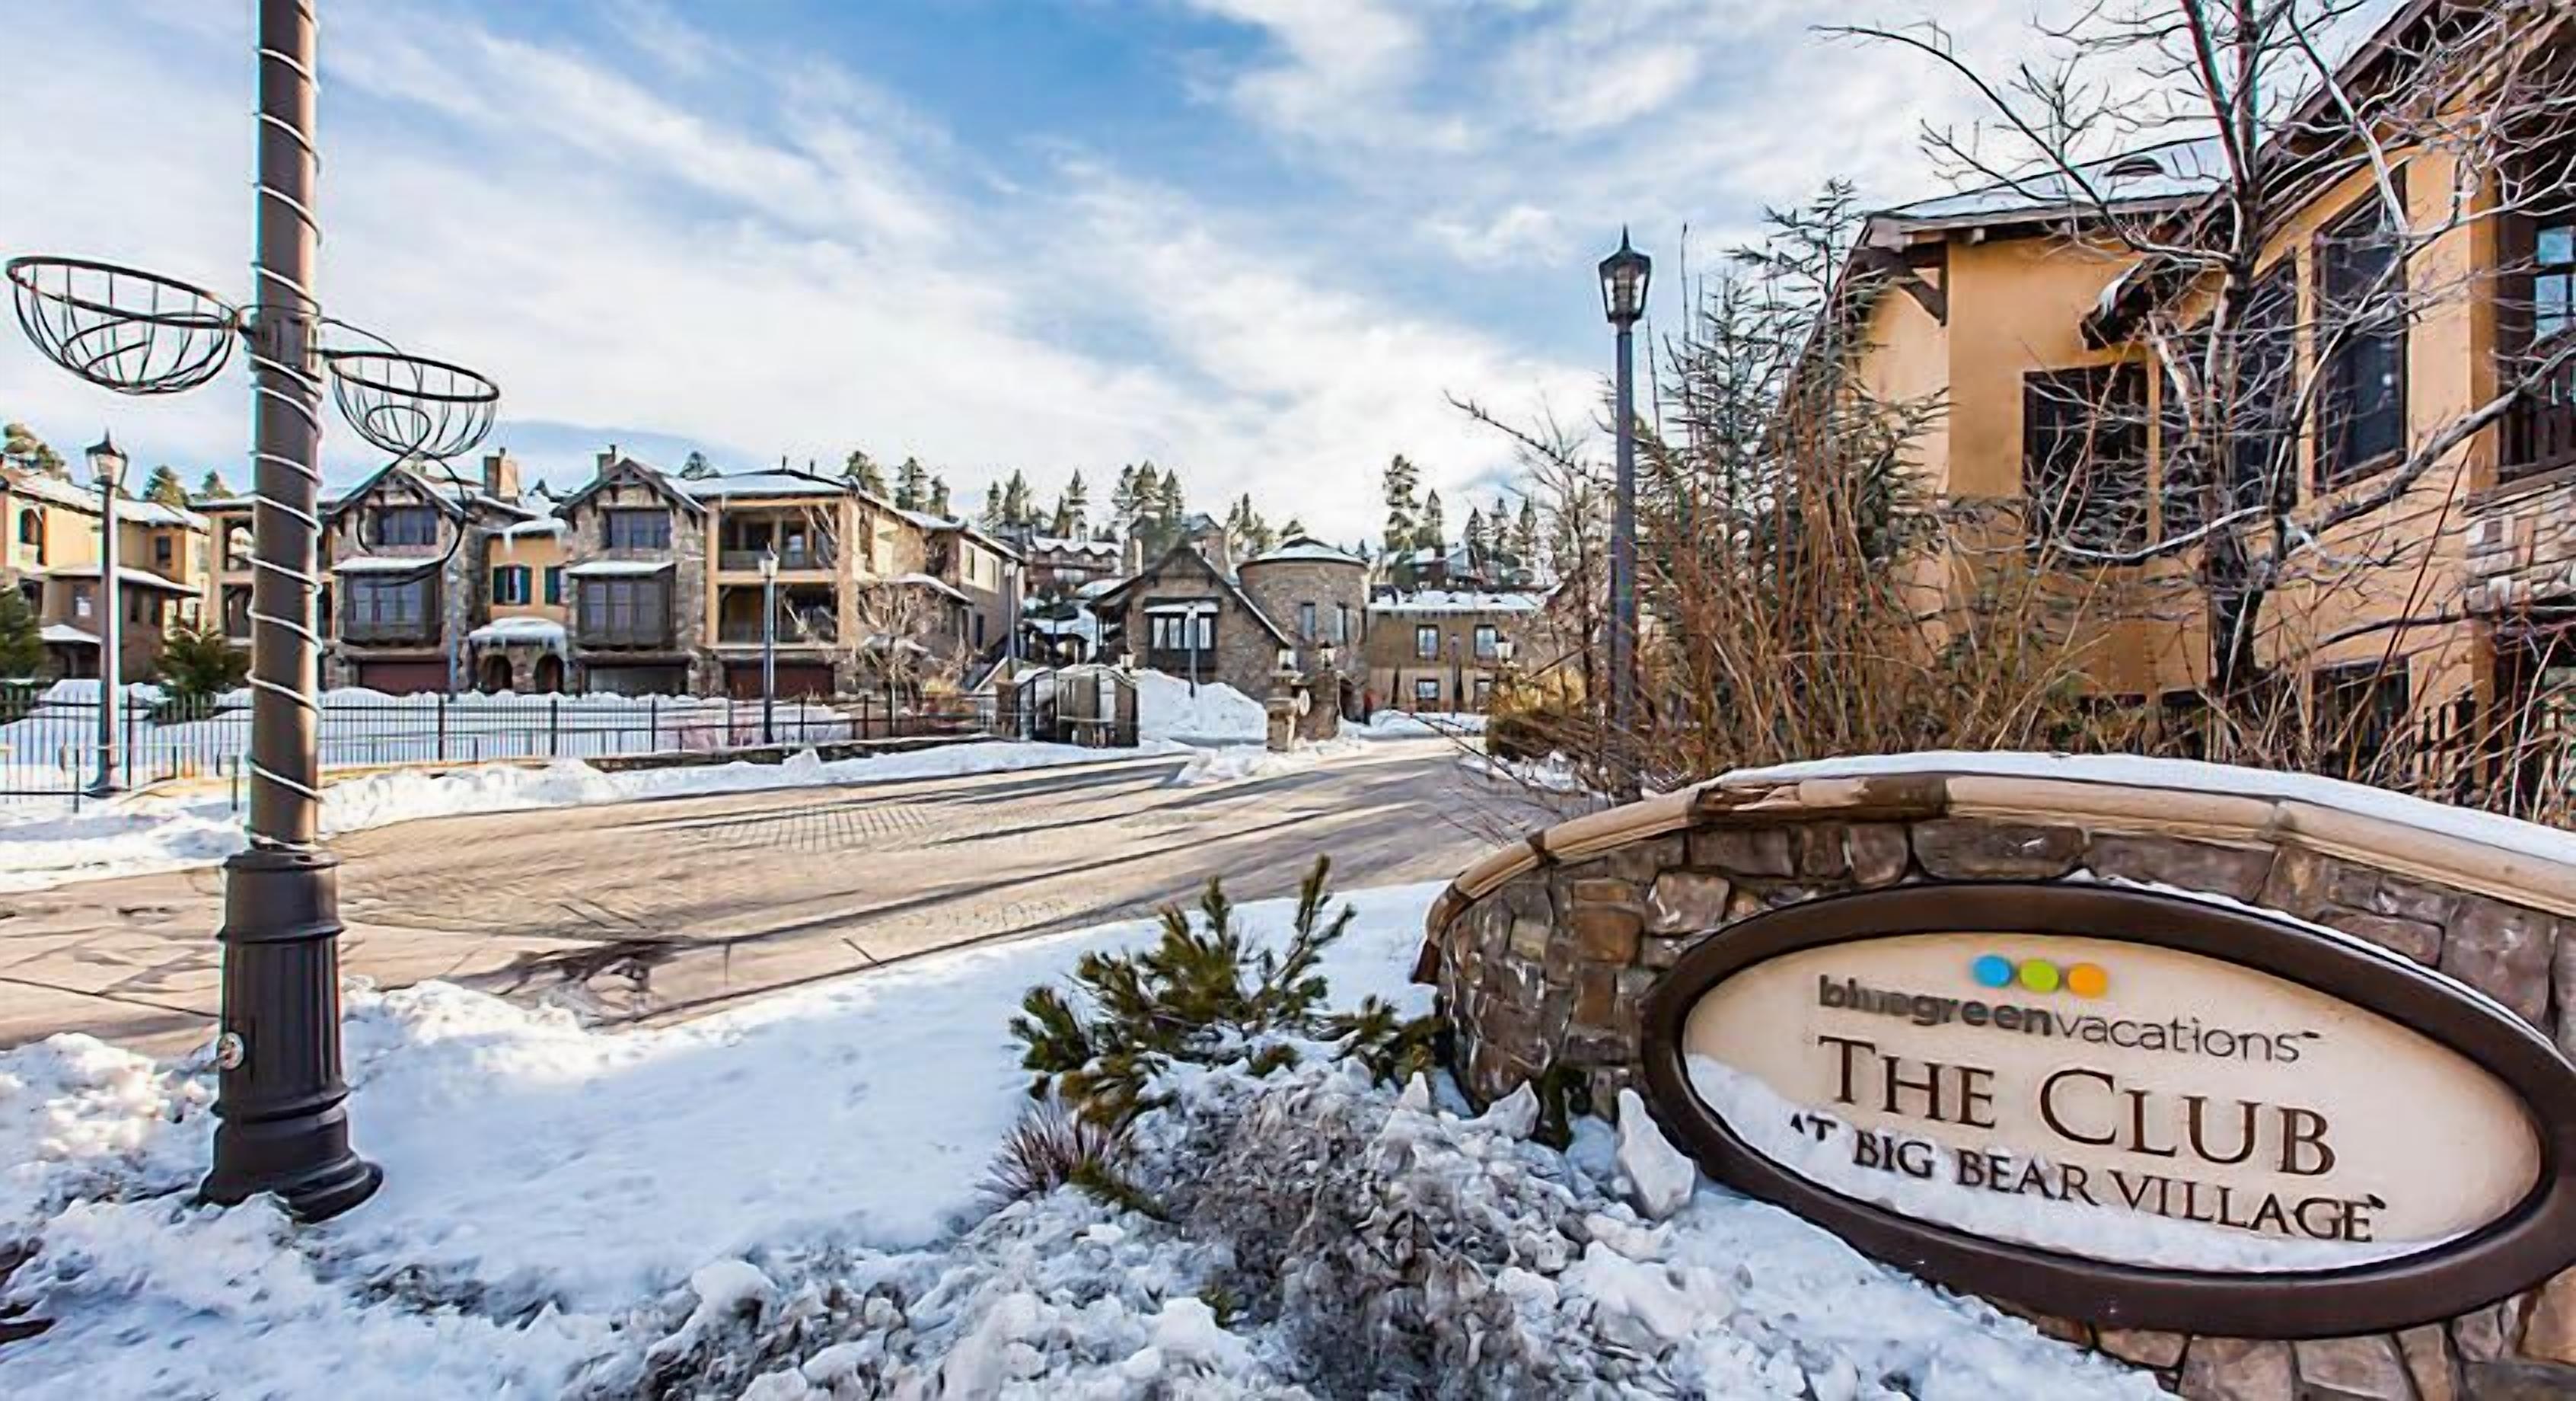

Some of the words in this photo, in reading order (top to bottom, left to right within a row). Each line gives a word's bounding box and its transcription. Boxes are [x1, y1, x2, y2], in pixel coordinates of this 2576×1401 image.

[1817, 1035, 1996, 1128] THE
[2039, 1068, 2336, 1176] CLUB
[1852, 1129, 1936, 1179] BIG
[1956, 1148, 2100, 1207] BEAR
[2107, 1169, 2375, 1243] VILLAGE
